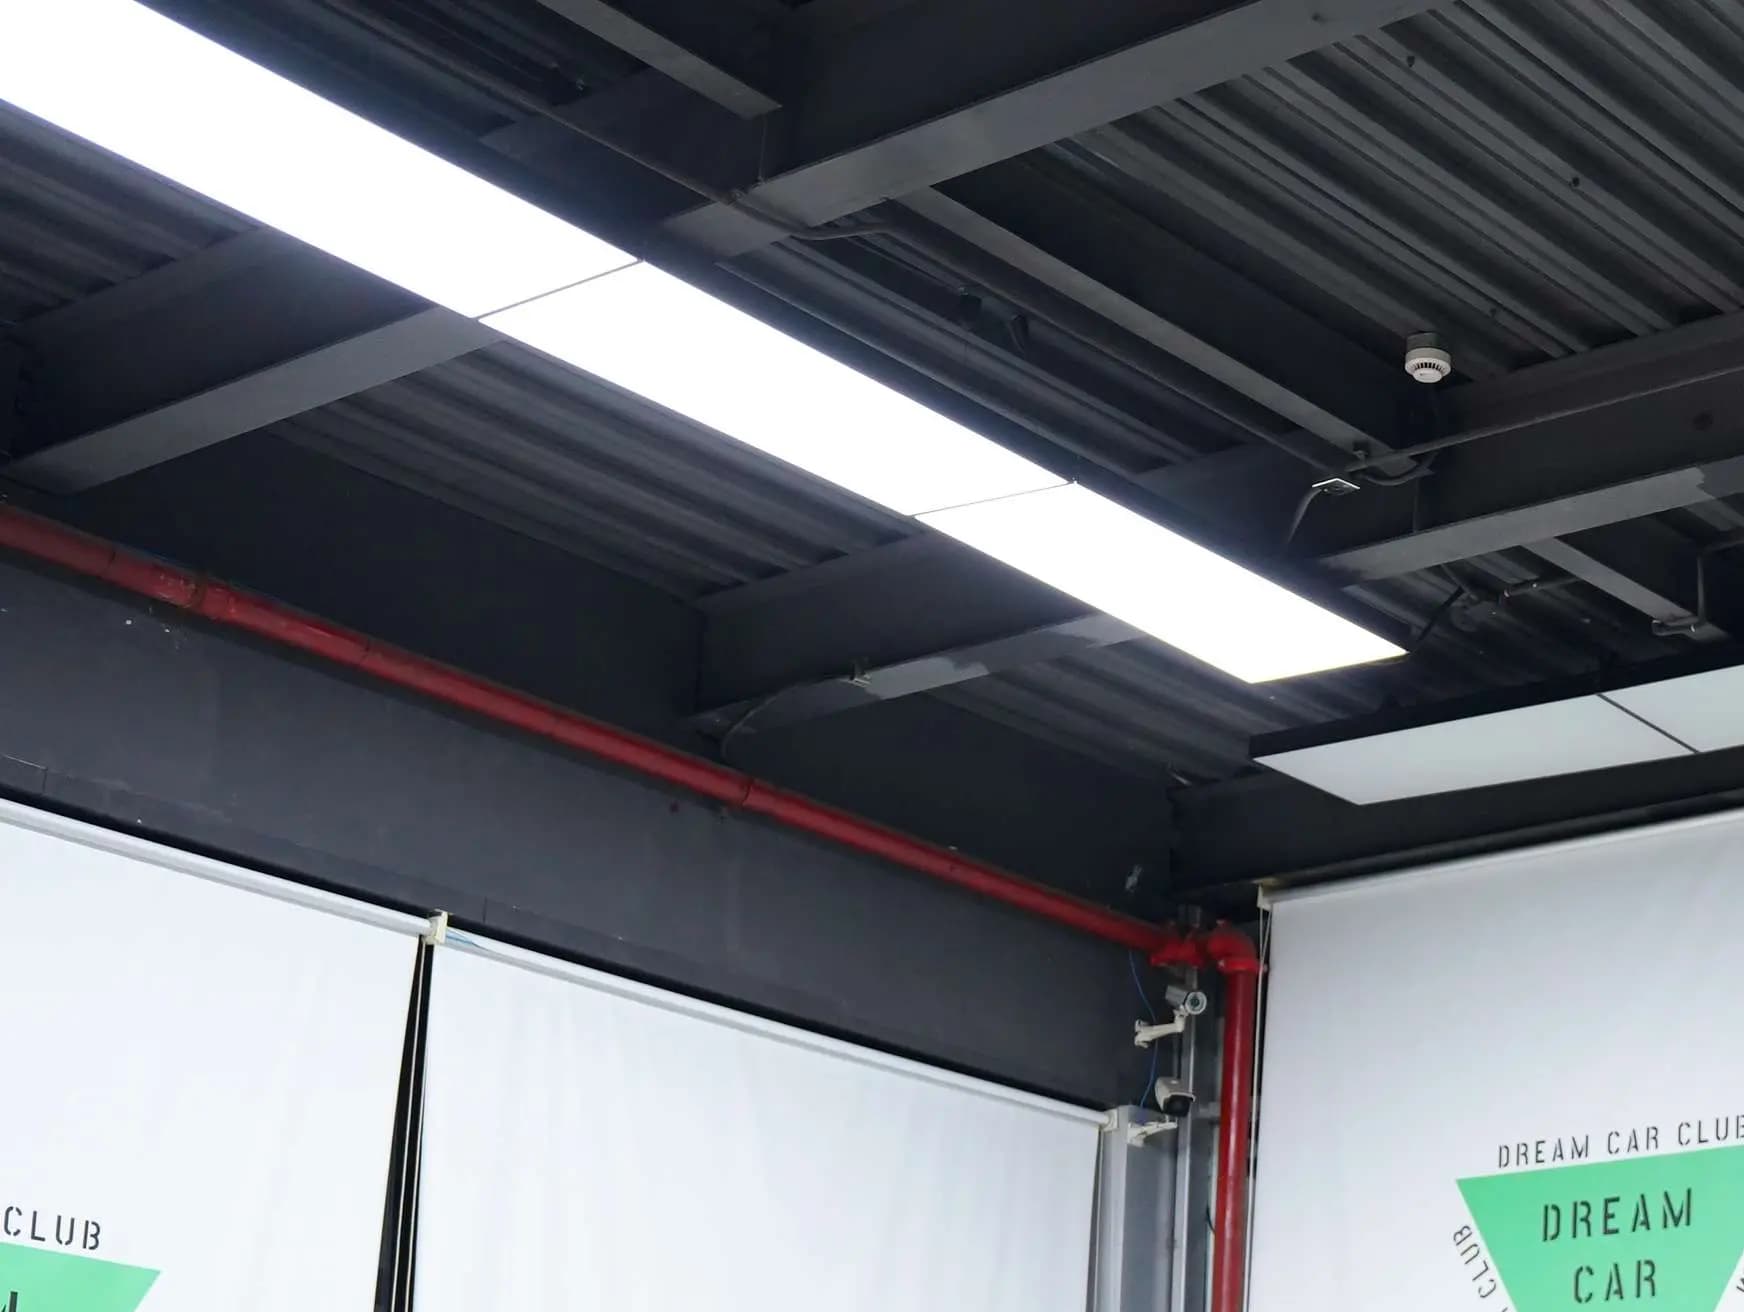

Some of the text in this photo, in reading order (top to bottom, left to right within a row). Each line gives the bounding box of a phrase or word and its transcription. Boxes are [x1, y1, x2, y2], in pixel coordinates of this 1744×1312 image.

[1498, 1135, 1590, 1169] DREAM
[1607, 1126, 1660, 1155] CAR
[3, 1206, 101, 1250] CLUB
[1541, 1187, 1692, 1243] DREAM
[1452, 1224, 1497, 1299] CLUB
[1573, 1259, 1656, 1304] CAR
